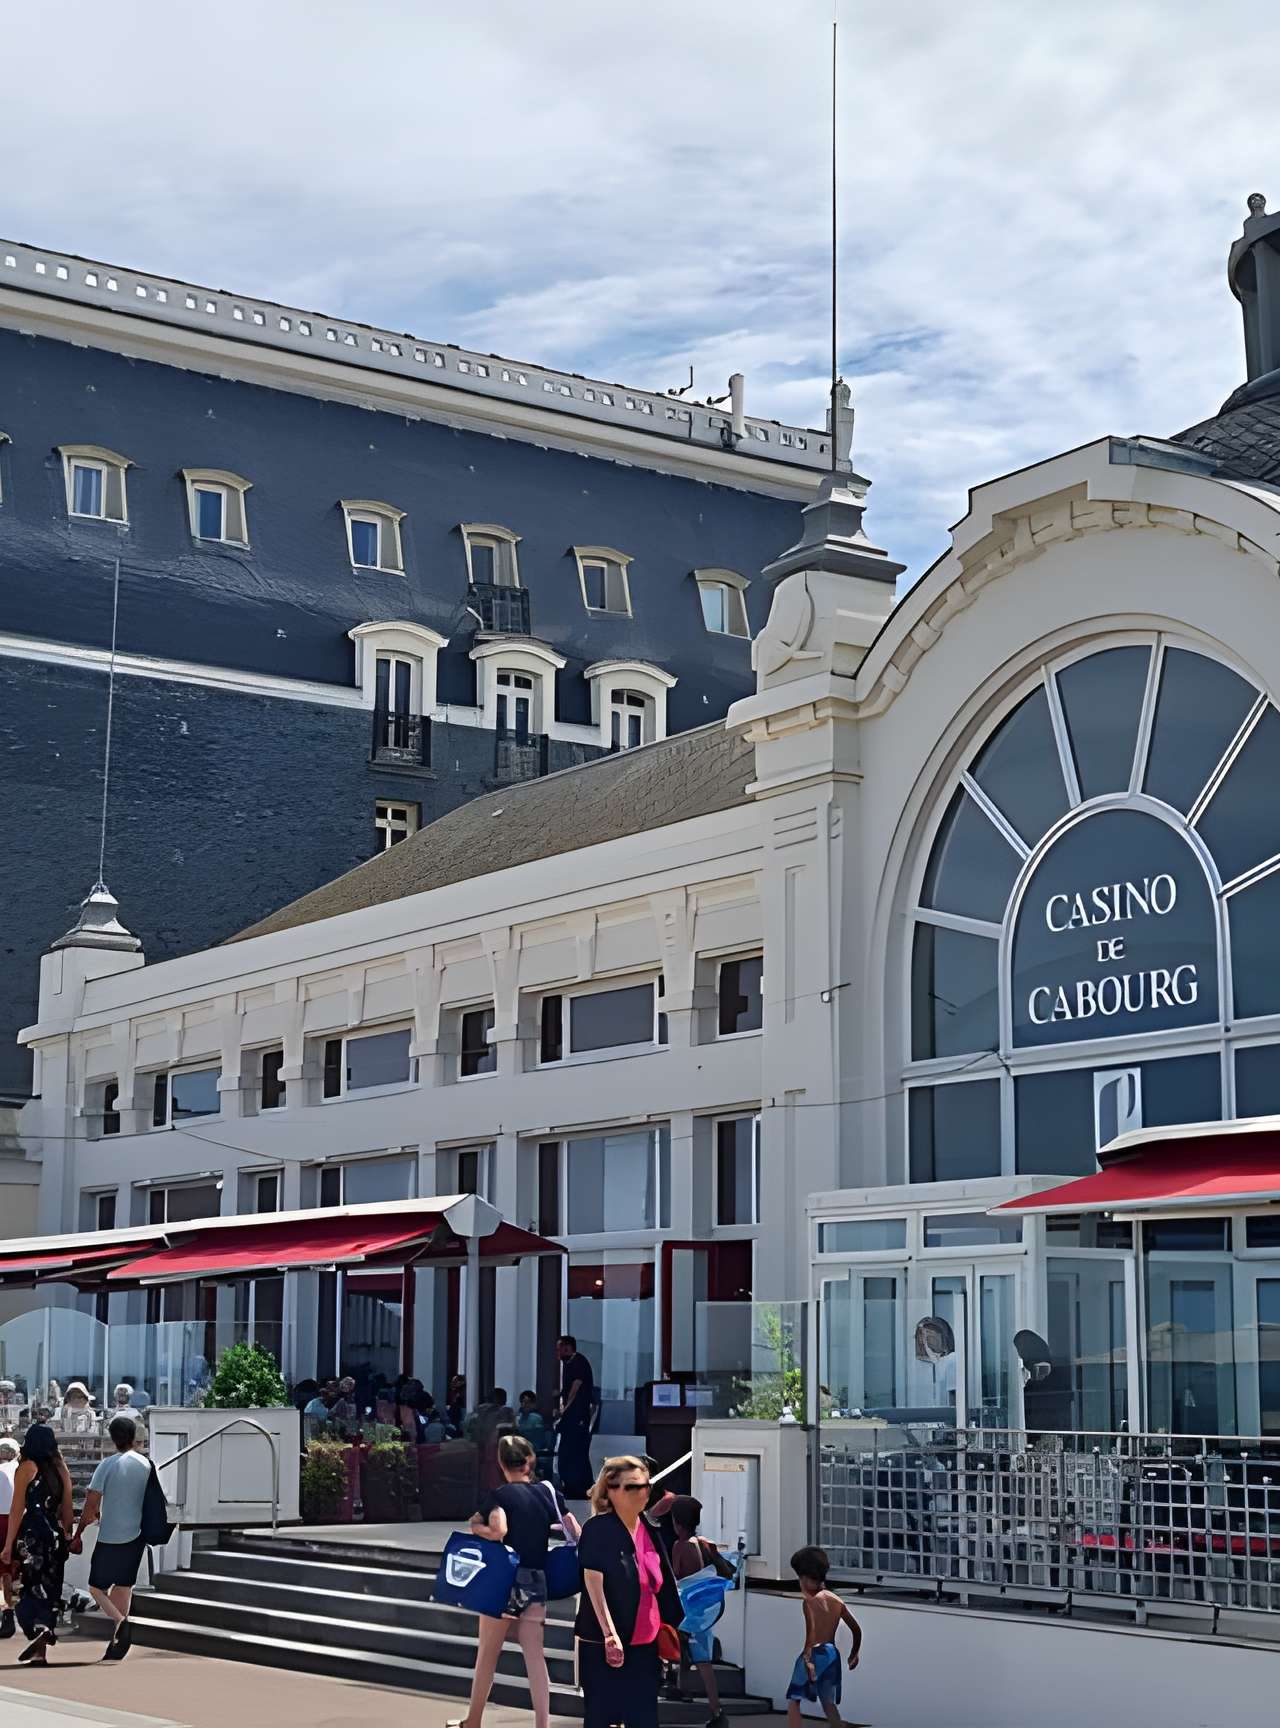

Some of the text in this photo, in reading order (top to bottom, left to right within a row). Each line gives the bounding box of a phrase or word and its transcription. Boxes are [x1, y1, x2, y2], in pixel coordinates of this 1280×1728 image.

[1045, 874, 1177, 932] CASINO
[1096, 936, 1125, 962] DE
[1028, 964, 1198, 1025] CABOURG
